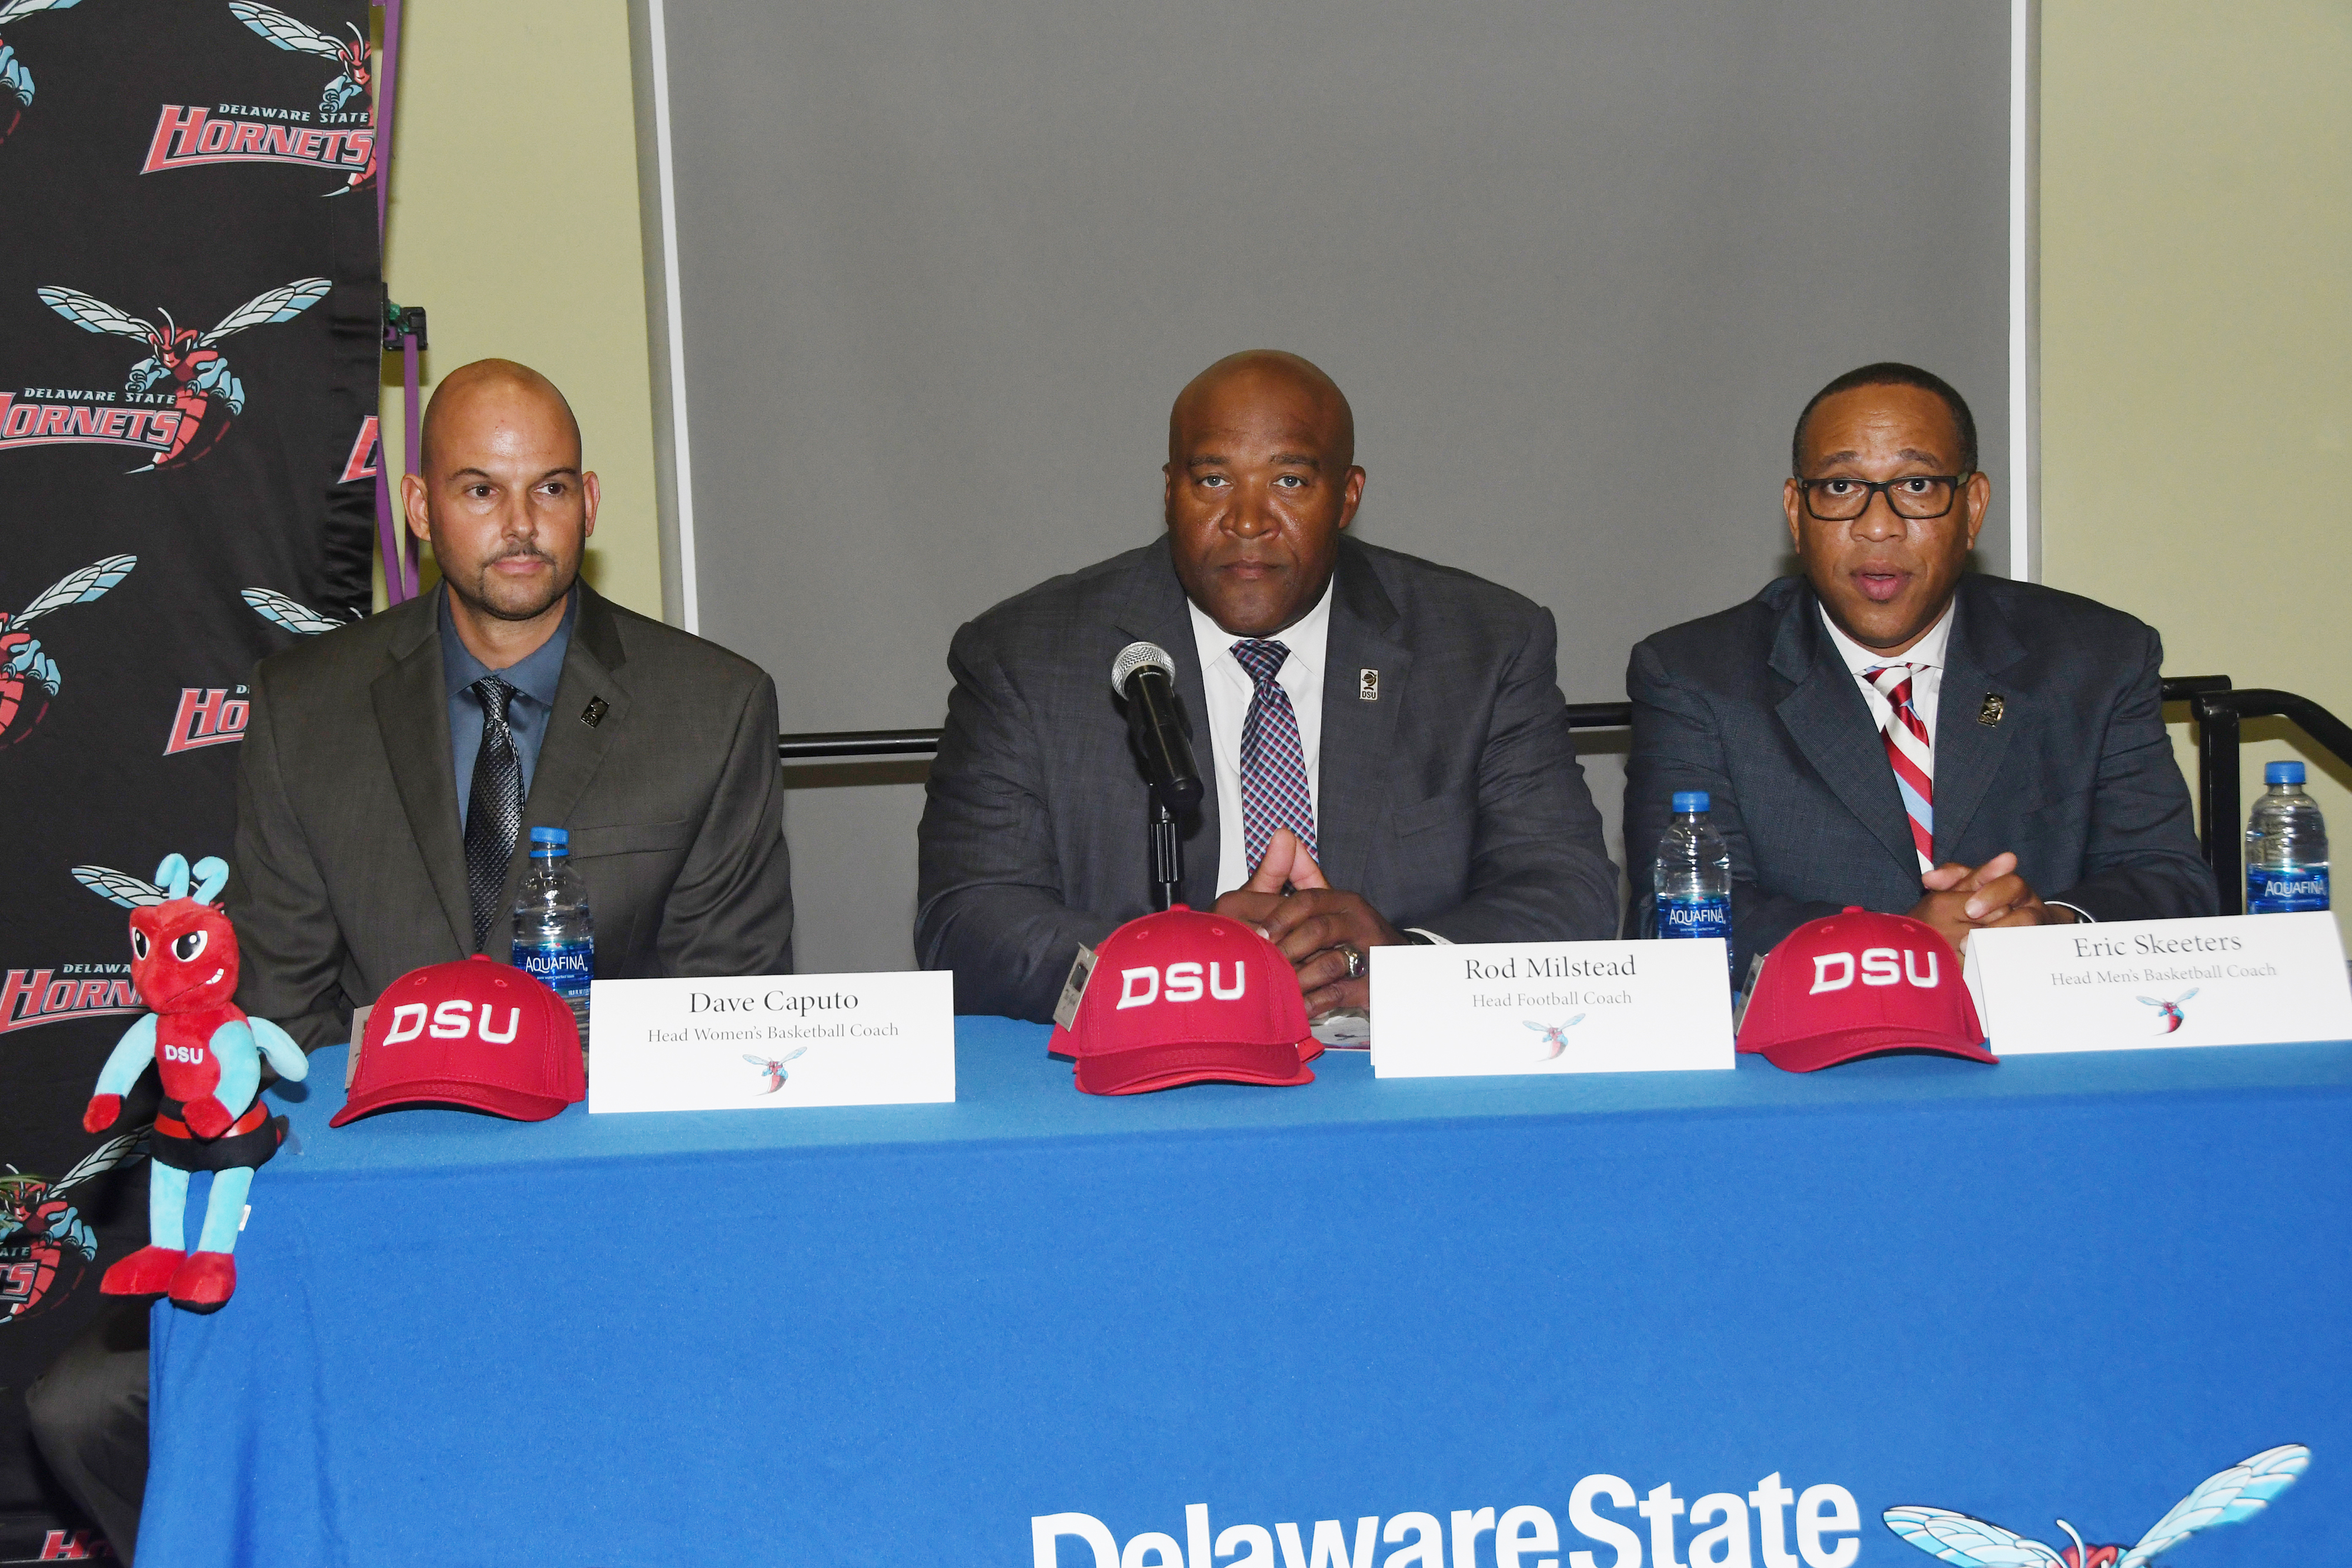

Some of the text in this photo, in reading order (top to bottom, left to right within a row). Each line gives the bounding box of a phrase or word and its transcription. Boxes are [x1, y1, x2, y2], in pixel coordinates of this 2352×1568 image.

[219, 103, 370, 123] DELAWARE STATE
[140, 104, 375, 175] HORNETS
[24, 387, 176, 404] DELAWARE STATE
[0, 392, 182, 450] ORNETS
[1362, 691, 1376, 699] DSU
[2264, 880, 2326, 897] AQUAFINA
[1669, 907, 1723, 926] AQUAFINA
[2072, 933, 2242, 958] Eric Skeeters
[63, 964, 131, 973] DELAWA
[526, 954, 586, 974] AQUAFINA
[1464, 954, 1637, 980] Rod Milstead
[1809, 948, 1939, 995] DSU
[2051, 962, 2277, 986] Head Men's Basketball Coach
[1117, 961, 1245, 1010] DSU
[0, 969, 149, 1034] HORN
[689, 990, 858, 1017] Dave Caputo
[1473, 990, 1632, 1008] Head Football Coach
[382, 999, 520, 1047] DSU
[649, 1022, 899, 1043] Head Women's Basketball Coach
[165, 1044, 203, 1065] DSU
